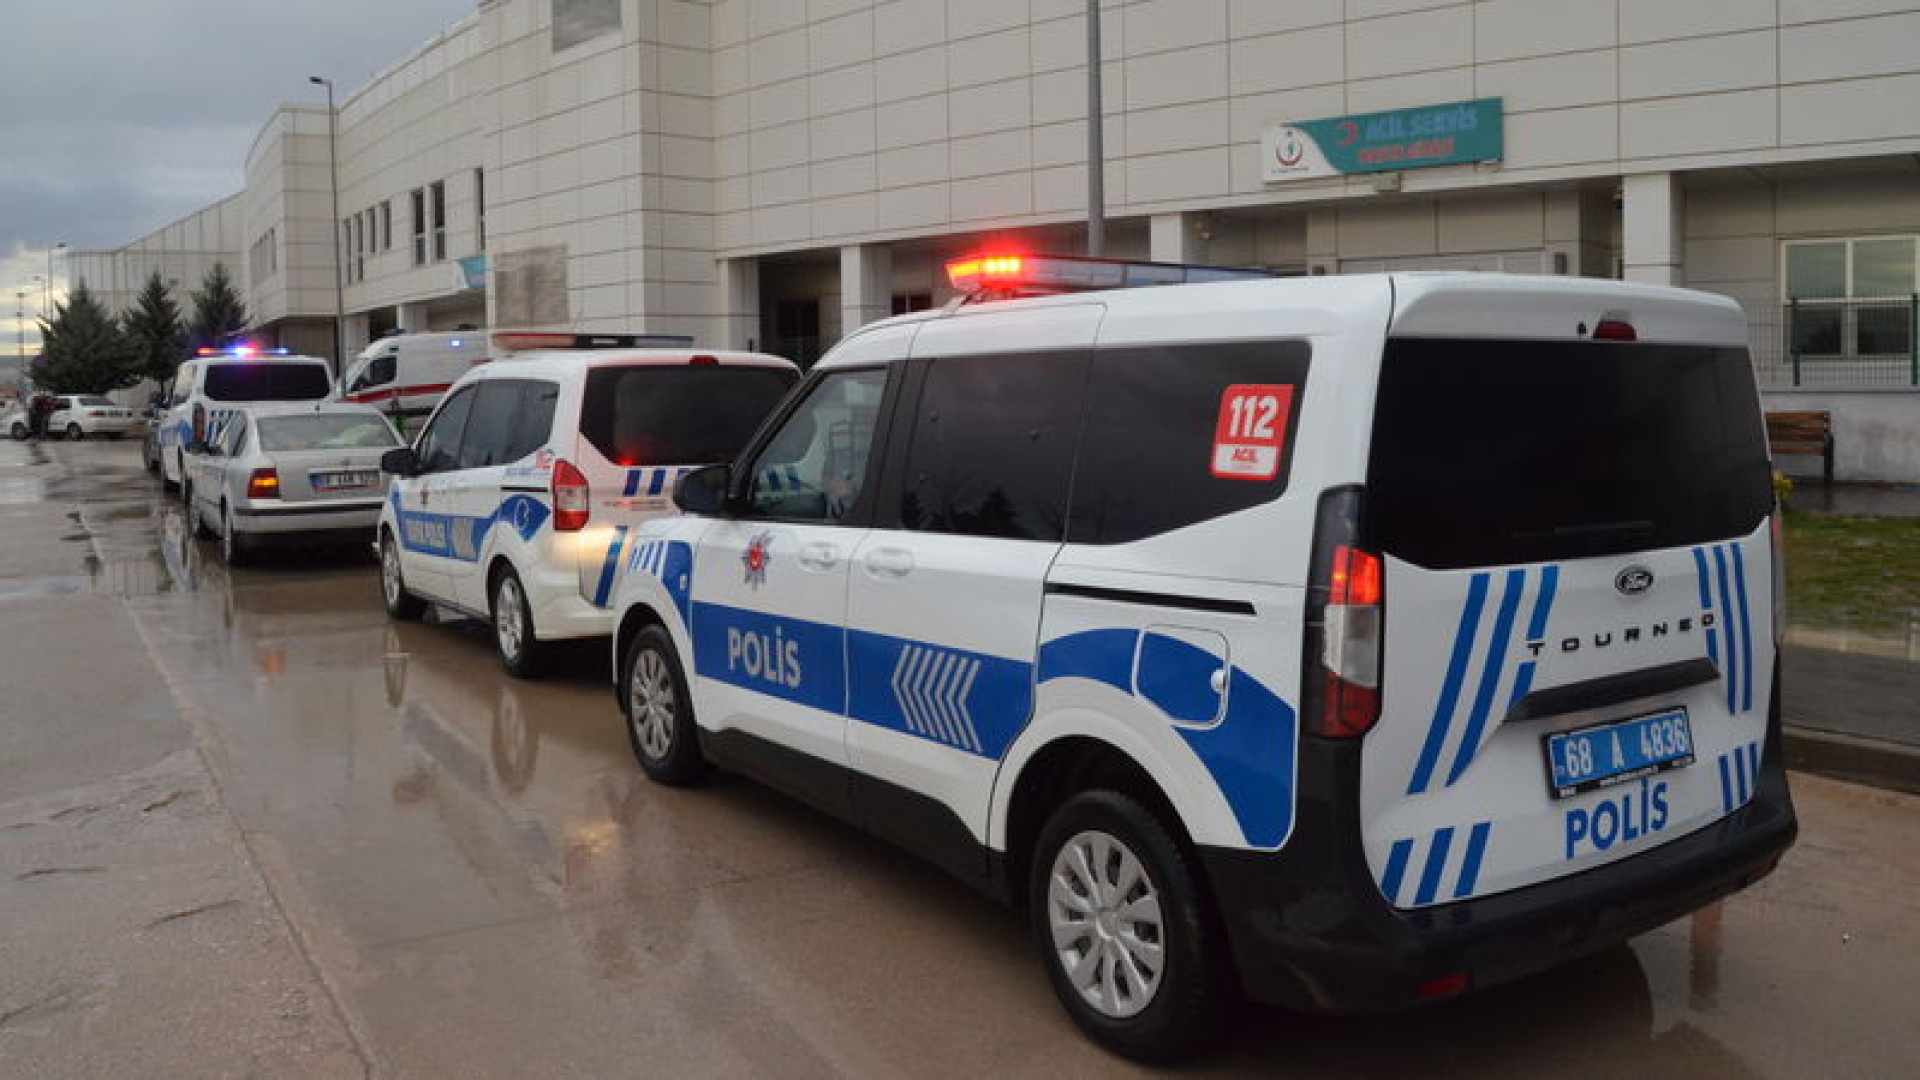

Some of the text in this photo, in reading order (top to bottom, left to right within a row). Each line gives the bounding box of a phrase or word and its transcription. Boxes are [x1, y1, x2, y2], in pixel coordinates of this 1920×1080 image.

[1228, 395, 1279, 438] 112
[727, 625, 802, 688] POLİS
[1527, 612, 1715, 656] TOURNEO
[1565, 737, 1593, 778] 68
[1612, 729, 1625, 768] A
[1566, 777, 1668, 860] POLİS
